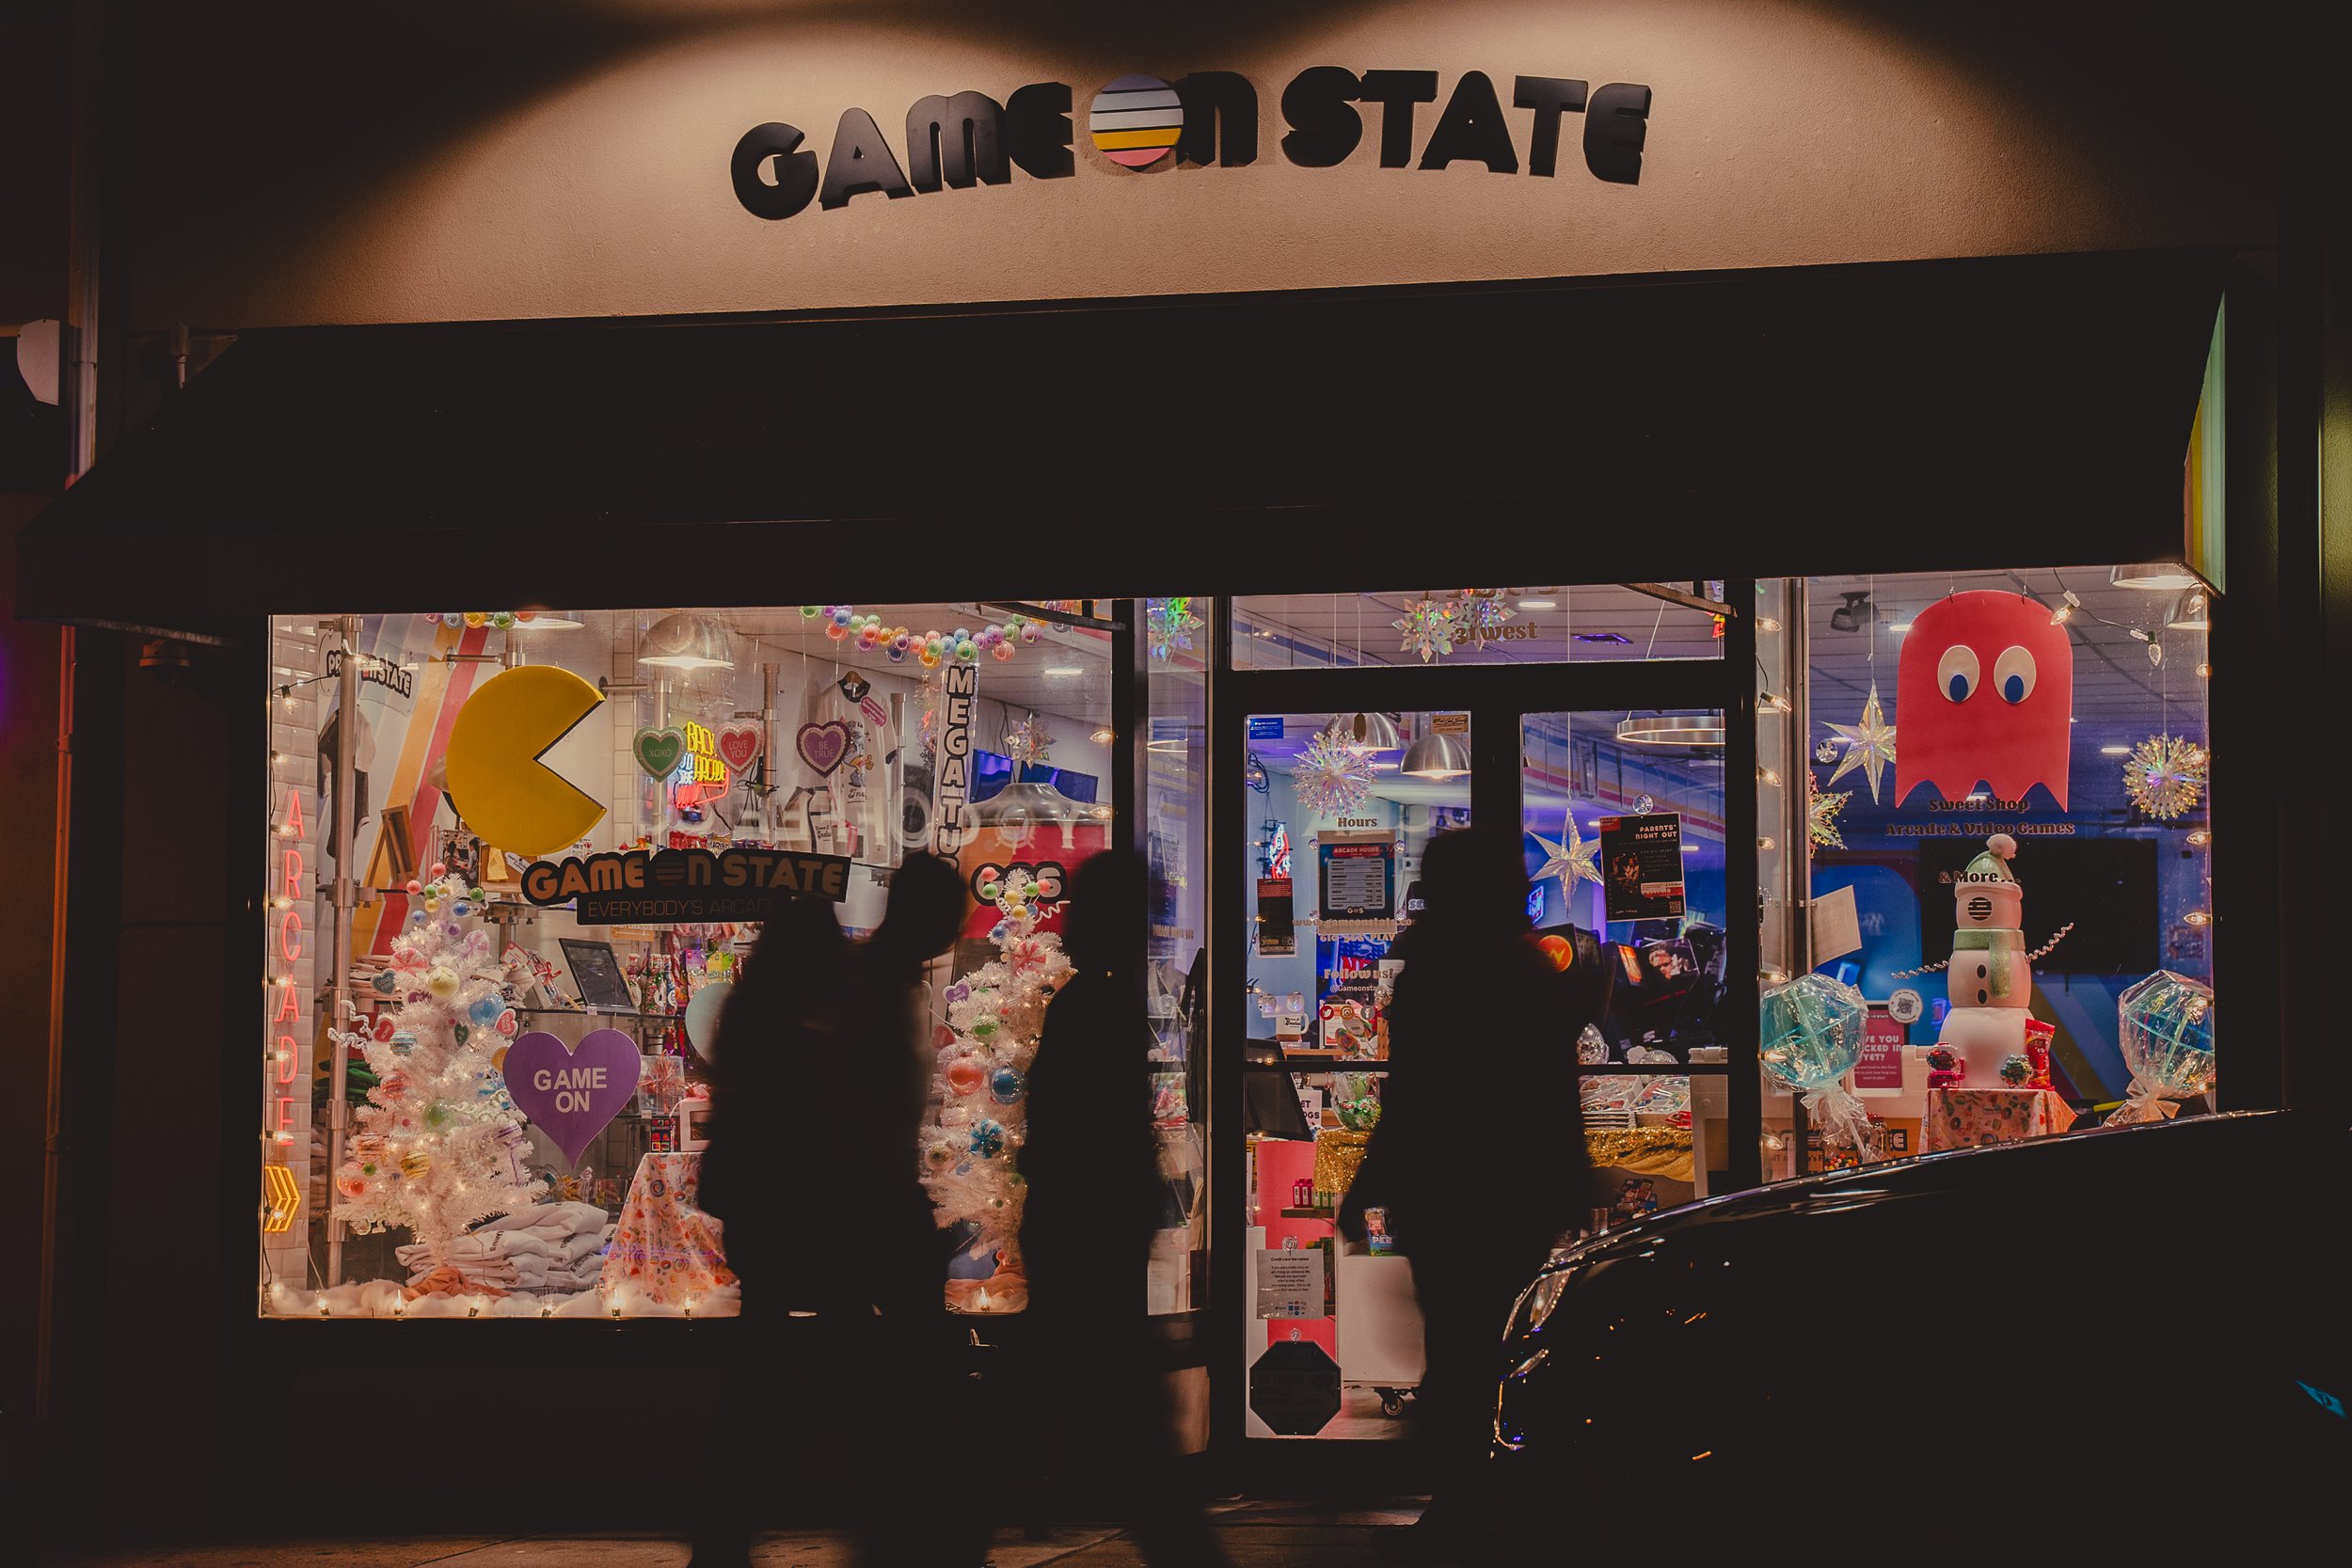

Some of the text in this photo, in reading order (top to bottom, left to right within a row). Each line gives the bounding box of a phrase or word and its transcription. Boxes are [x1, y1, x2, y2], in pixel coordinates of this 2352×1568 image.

[730, 81, 1078, 221] GAME
[1279, 66, 1652, 185] STATE
[728, 739, 749, 750] LOVE
[818, 740, 829, 751] BE
[648, 748, 673, 759] XOXO
[730, 749, 748, 759] YOU
[813, 749, 835, 760] TRUE
[1929, 798, 2030, 814] Sweet Shop
[1338, 816, 1377, 828] Hours
[1884, 821, 2076, 836] Arcade & Video Games
[1635, 831, 1677, 841] NIGHT OUT
[527, 856, 644, 900] GAME
[723, 854, 845, 895] STATE
[1938, 870, 1951, 884] &
[587, 898, 778, 918] EVERYBODY'S ARCAD
[274, 788, 305, 1147] ARCADE
[1324, 968, 1372, 980] Follow
[1373, 967, 1394, 980] us!
[1878, 1035, 1900, 1043] YOU
[1864, 1044, 1889, 1053] CKED
[1863, 1053, 1885, 1062] YET?
[533, 1067, 608, 1091] GAME
[555, 1090, 590, 1114] ON
